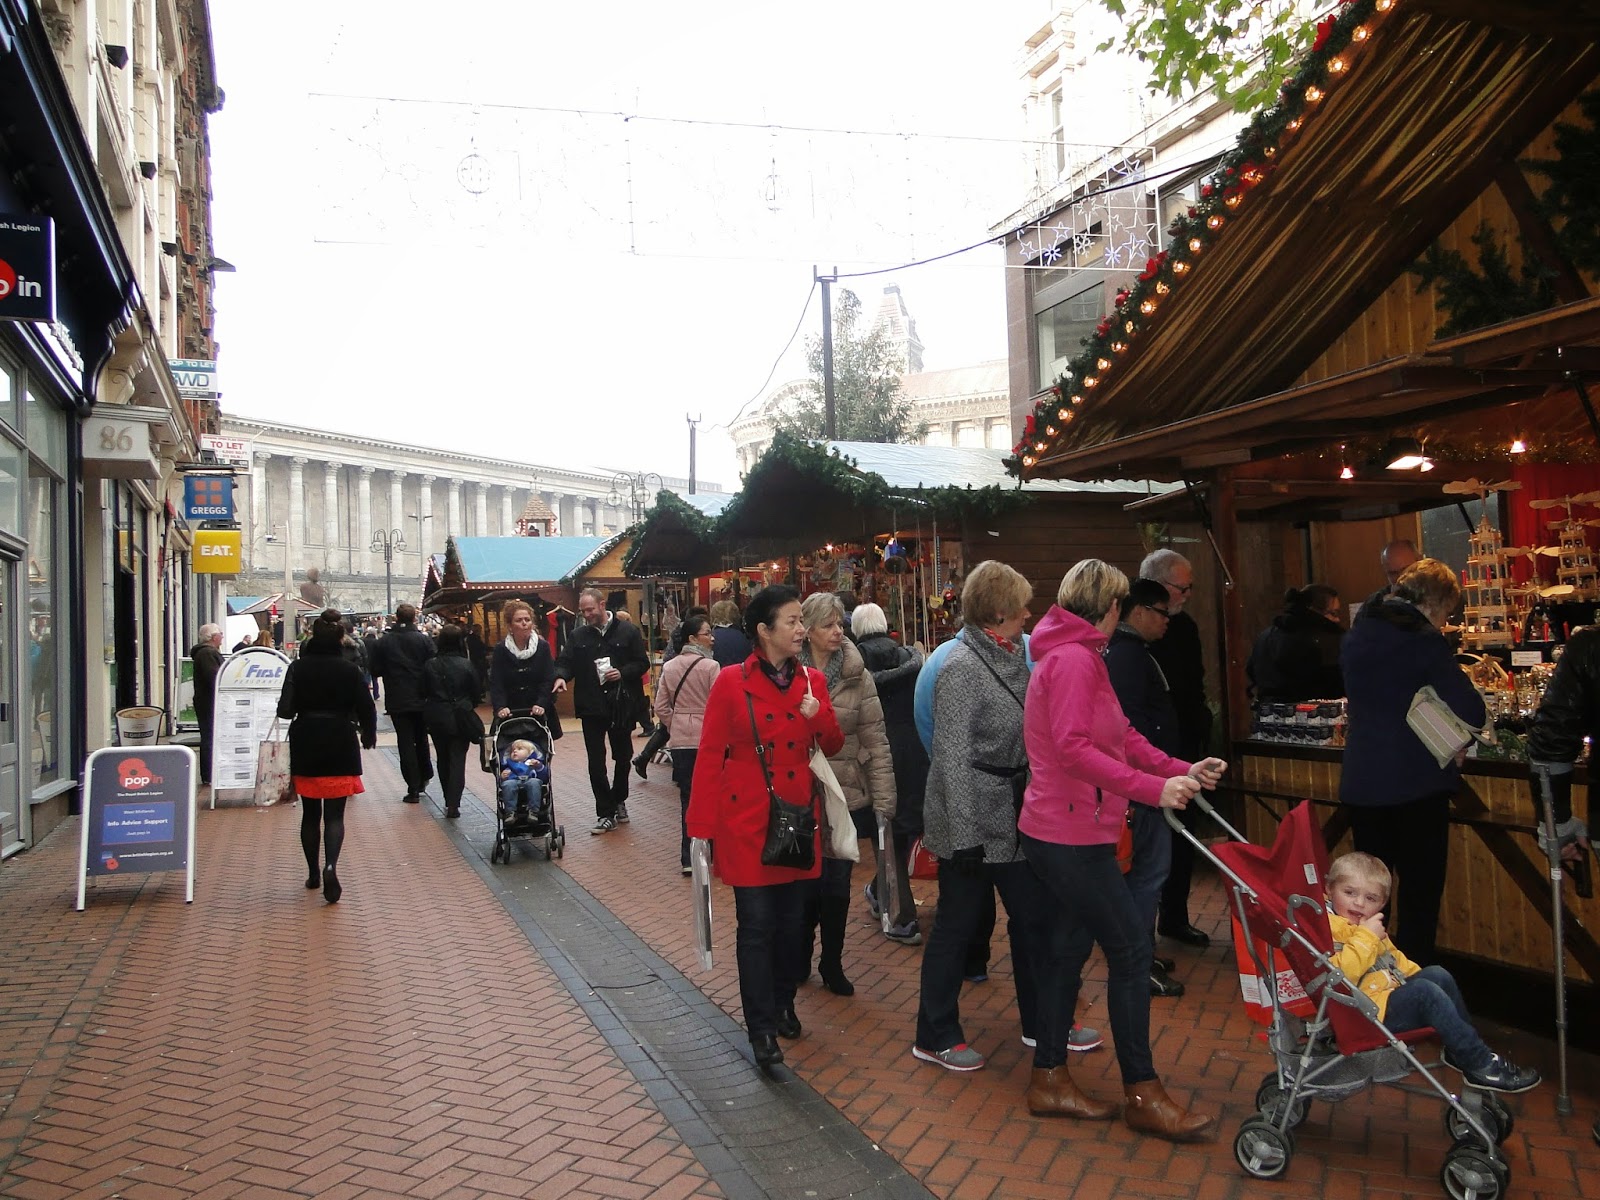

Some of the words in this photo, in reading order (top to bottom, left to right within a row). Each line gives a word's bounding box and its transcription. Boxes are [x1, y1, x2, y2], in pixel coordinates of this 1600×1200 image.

[11, 223, 41, 232] Legion
[18, 275, 42, 298] in
[101, 425, 133, 453] 86
[191, 506, 228, 515] GREGGS
[200, 545, 234, 556] EAT.
[245, 664, 283, 678] First
[124, 776, 150, 787] pop
[152, 776, 163, 784] in
